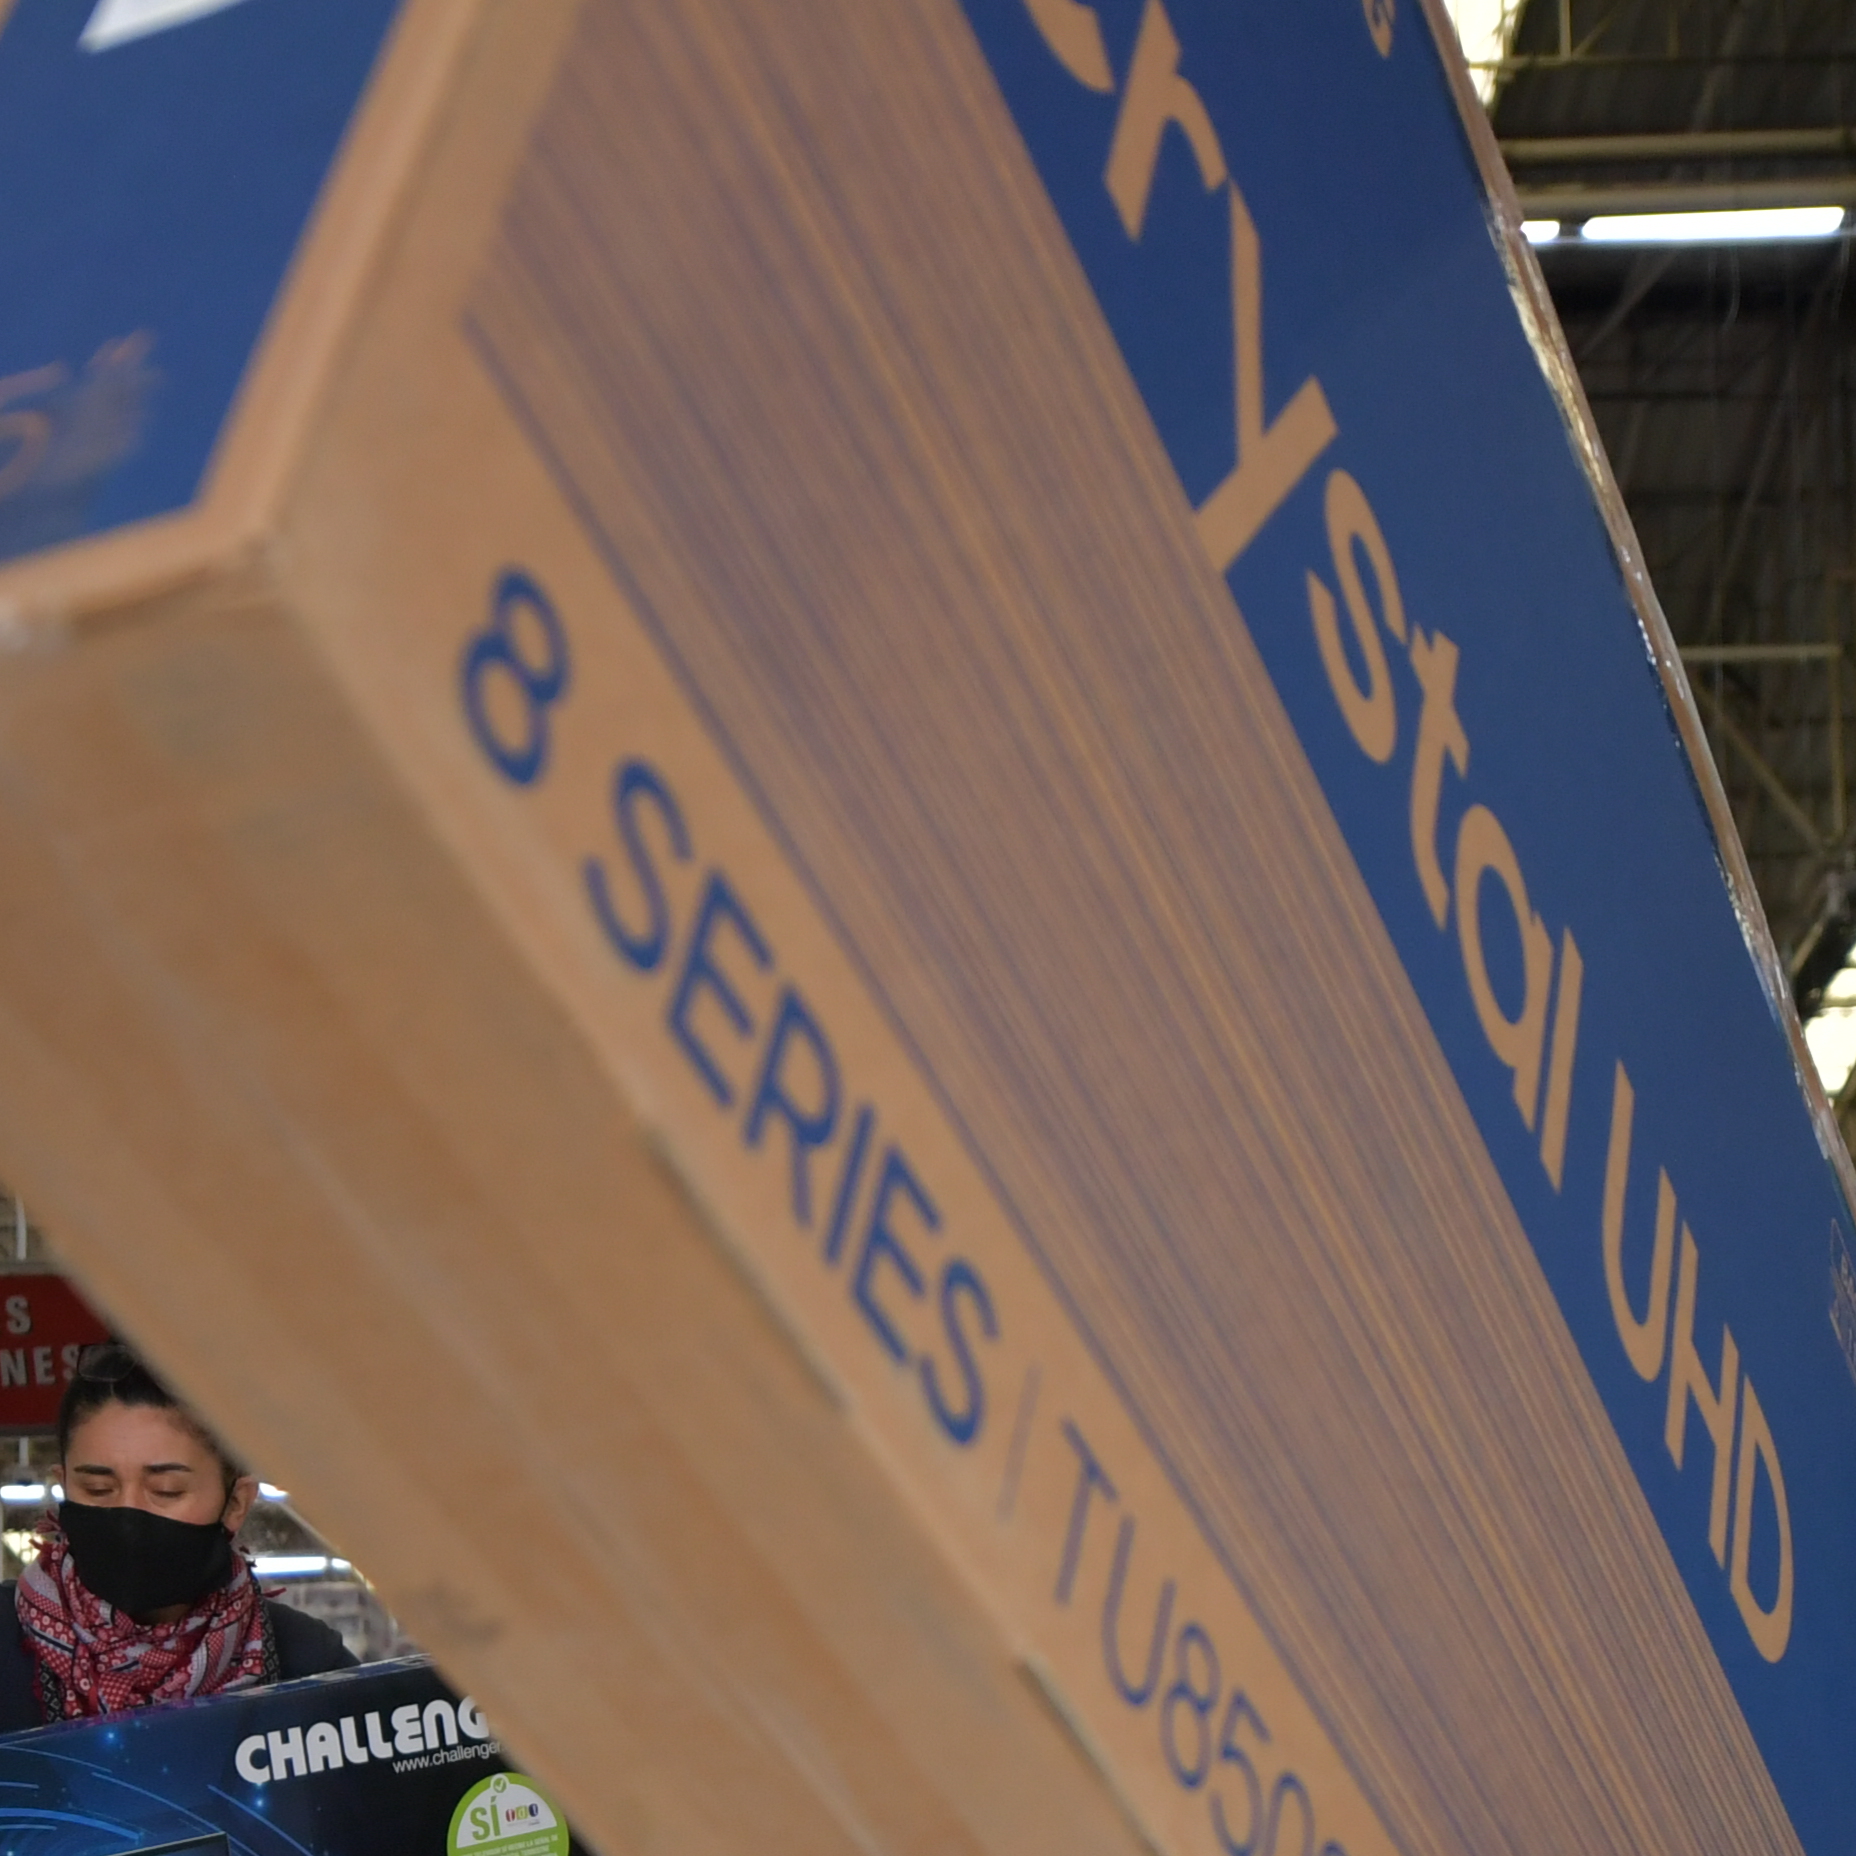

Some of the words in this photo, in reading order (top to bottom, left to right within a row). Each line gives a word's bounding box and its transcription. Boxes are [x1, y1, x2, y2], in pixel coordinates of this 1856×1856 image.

[458, 565, 571, 787] 8
[584, 755, 1000, 1448] SERIES
[1023, 0, 1583, 1194] rystal
[1600, 1058, 1794, 1664] UHD
[470, 1796, 501, 1840] SÍ
